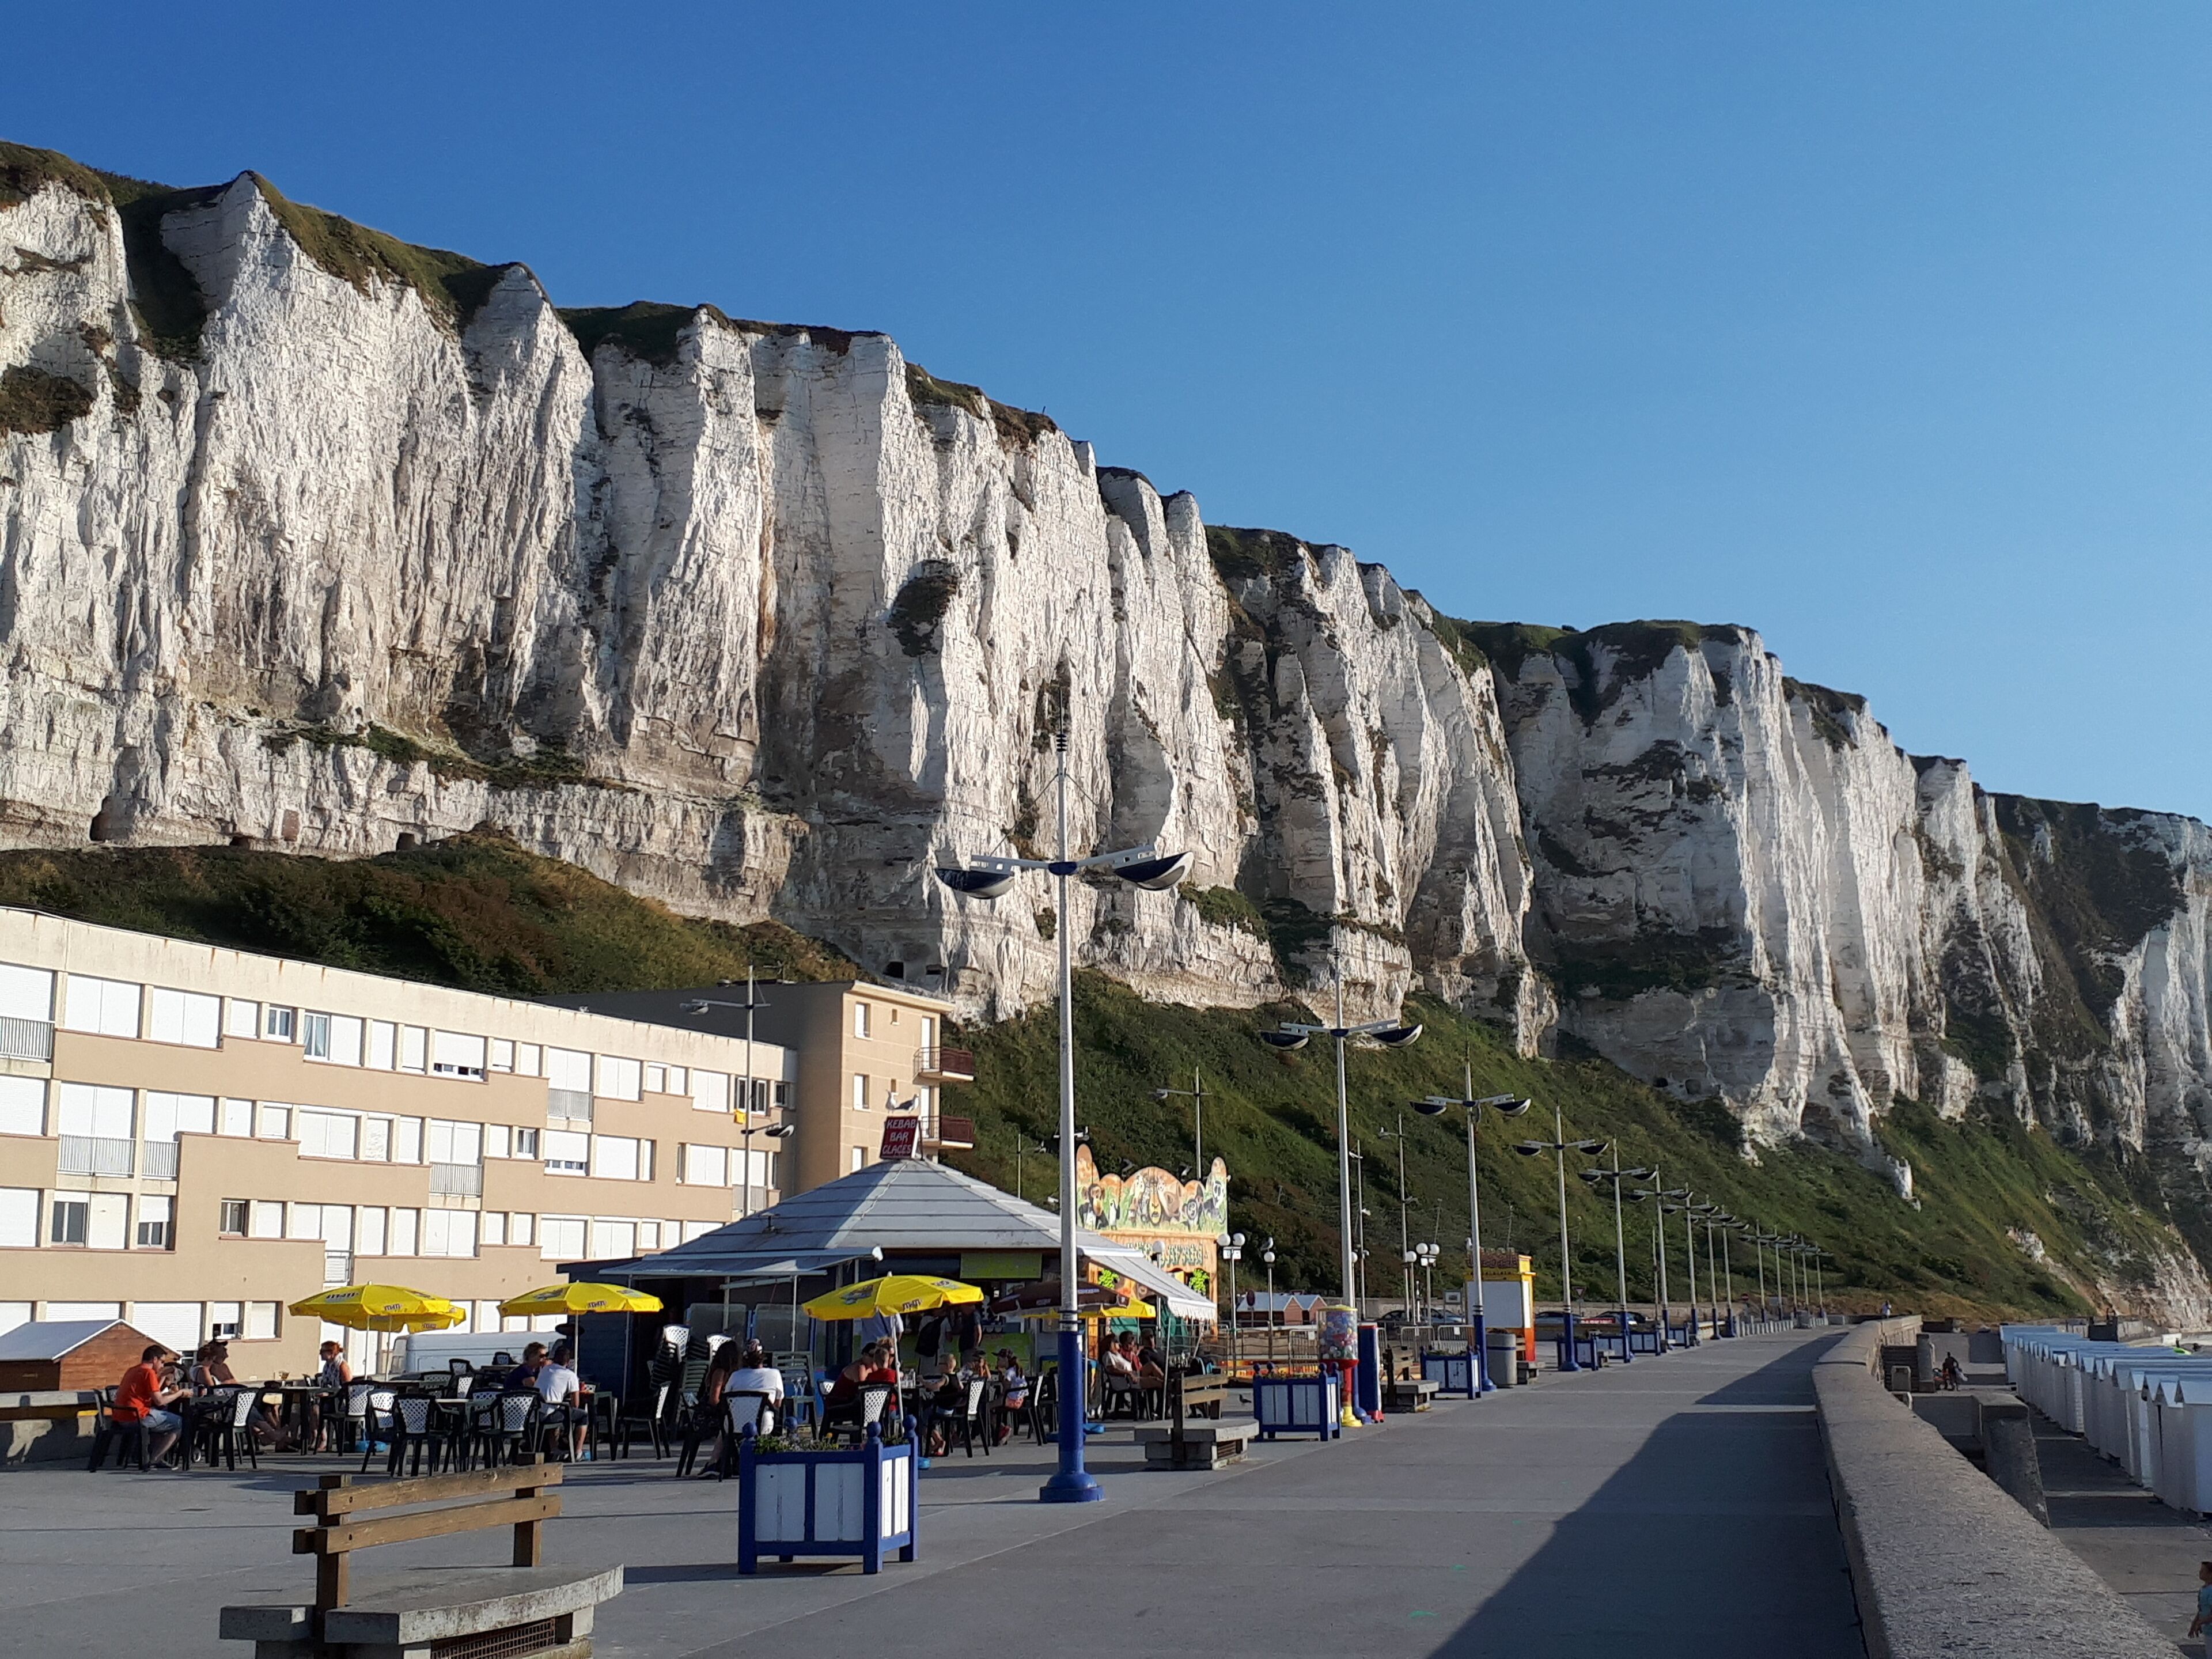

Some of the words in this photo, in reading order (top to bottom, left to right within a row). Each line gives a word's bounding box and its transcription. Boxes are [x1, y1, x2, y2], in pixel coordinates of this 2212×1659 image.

[887, 1119, 916, 1129] KEBAB
[889, 1132, 909, 1143] BAR
[882, 1144, 912, 1155] GLACES
